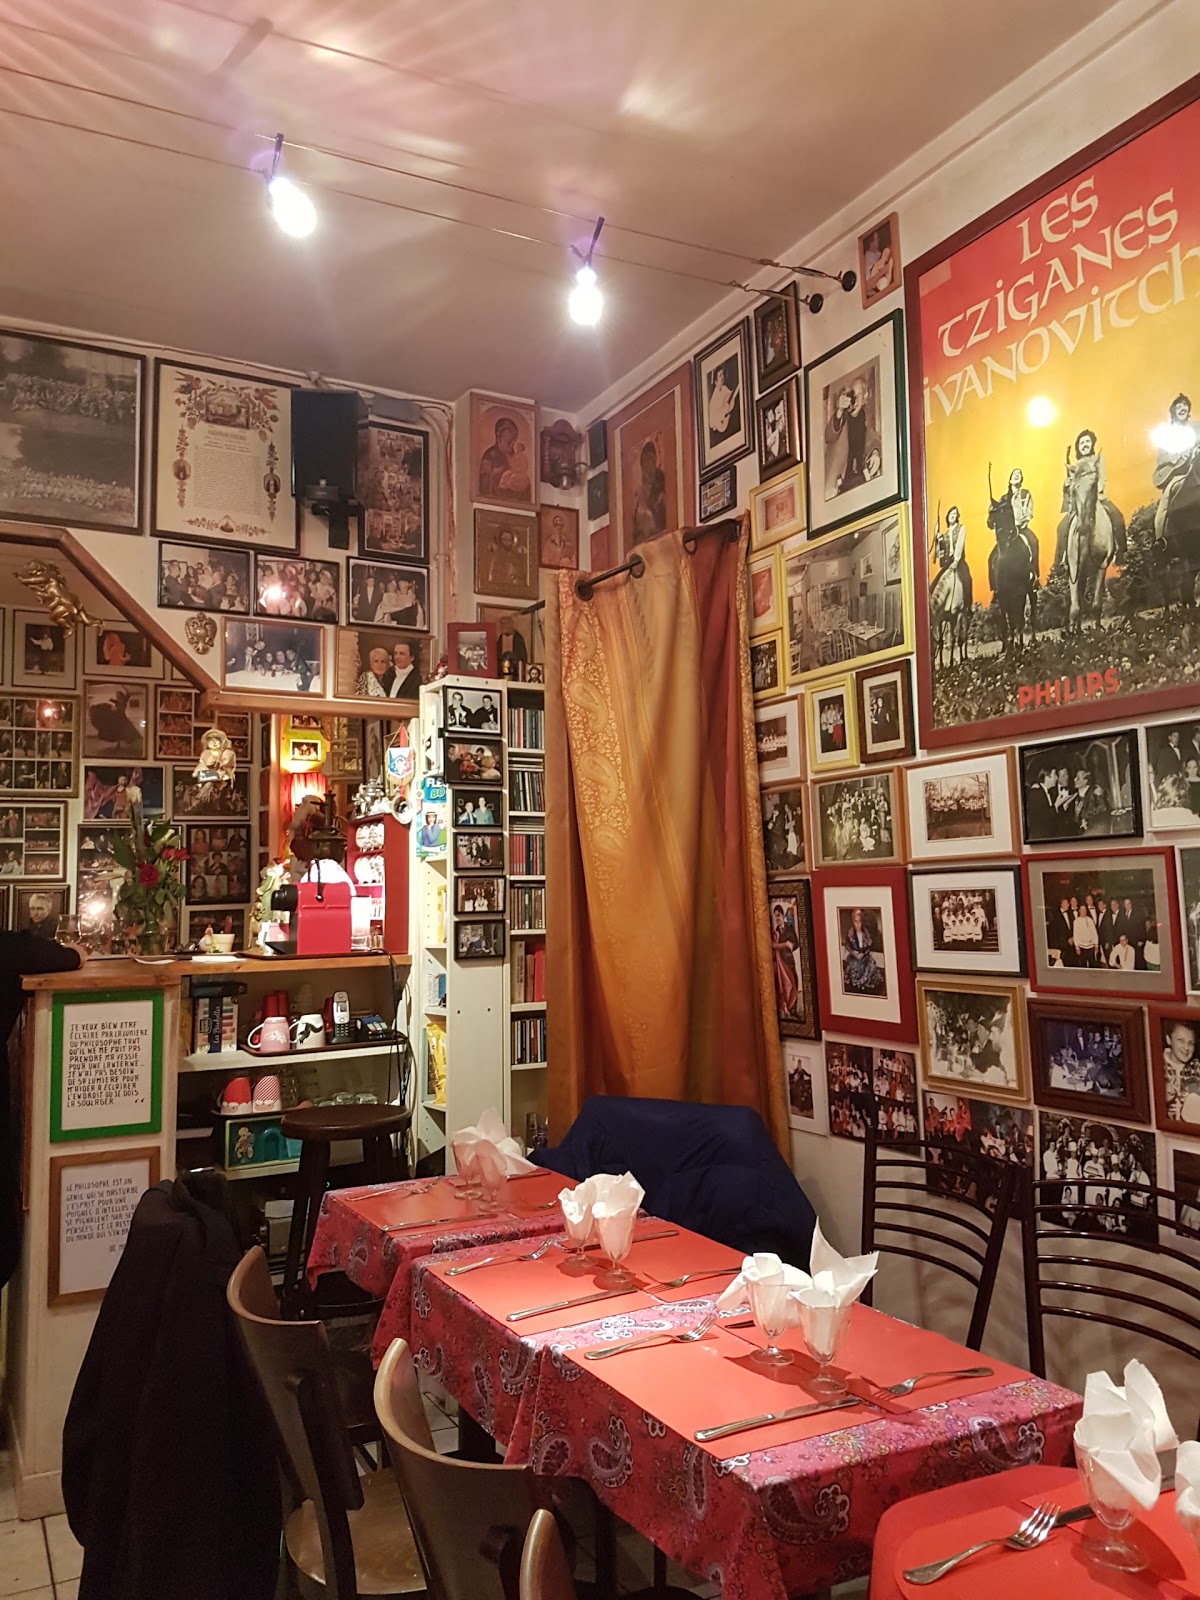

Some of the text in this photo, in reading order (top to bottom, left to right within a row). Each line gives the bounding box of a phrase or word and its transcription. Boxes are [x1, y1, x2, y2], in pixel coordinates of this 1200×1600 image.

[1017, 666, 1122, 711] PHILIPS
[70, 1024, 79, 1032] JE
[80, 1038, 121, 1046] PHILOSOPHE
[69, 1054, 102, 1062] PRENDRE
[68, 1062, 86, 1070] POUR
[109, 1068, 135, 1076] BESOIN
